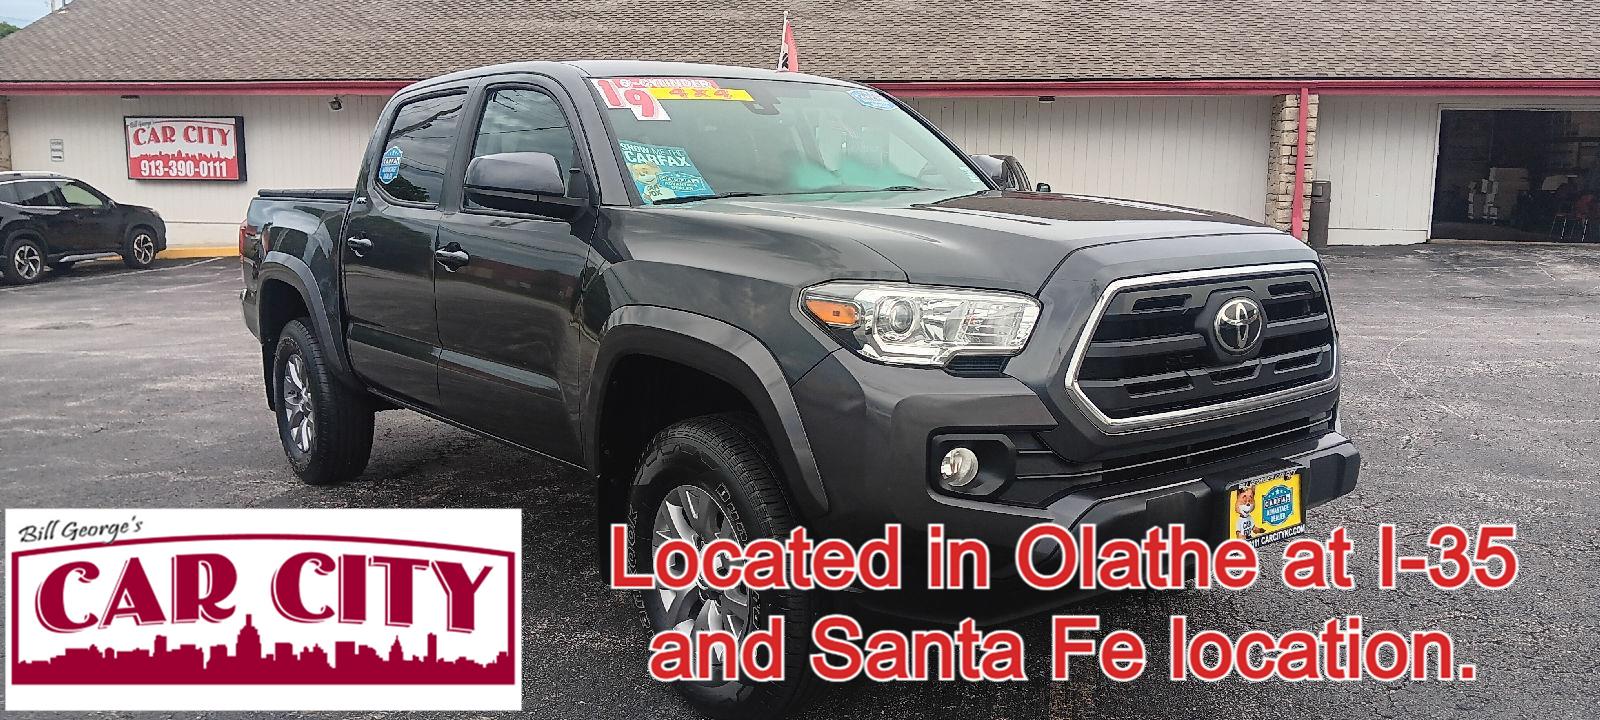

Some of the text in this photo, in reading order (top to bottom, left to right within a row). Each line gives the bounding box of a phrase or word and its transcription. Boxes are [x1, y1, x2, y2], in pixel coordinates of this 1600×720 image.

[133, 126, 230, 146] CAR CITY
[619, 142, 649, 154] SHOW
[623, 150, 692, 168] CARFAX
[140, 160, 227, 177] 913-390-0111
